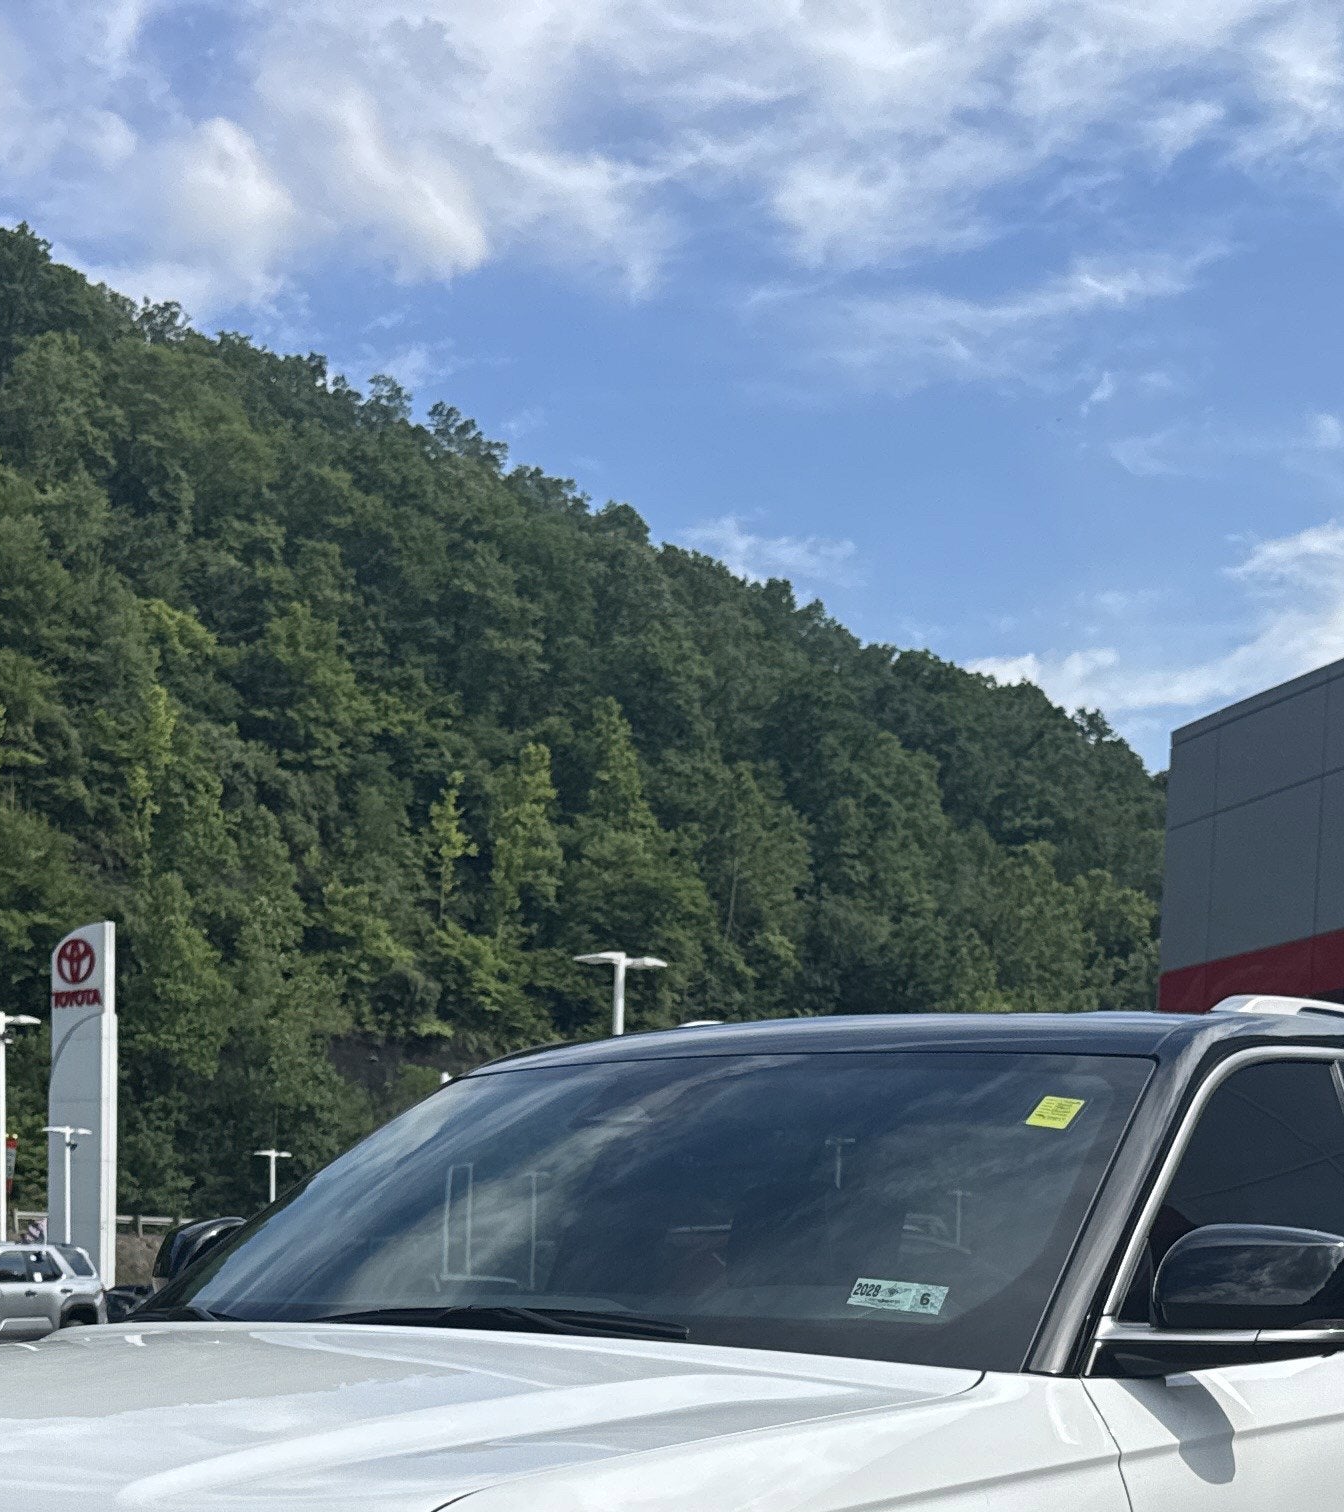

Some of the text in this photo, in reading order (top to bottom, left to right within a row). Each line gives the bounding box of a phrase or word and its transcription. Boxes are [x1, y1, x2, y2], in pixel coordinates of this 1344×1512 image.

[53, 988, 102, 1009] TOYOTA
[852, 1282, 882, 1297] 2028
[920, 1292, 931, 1305] 6
